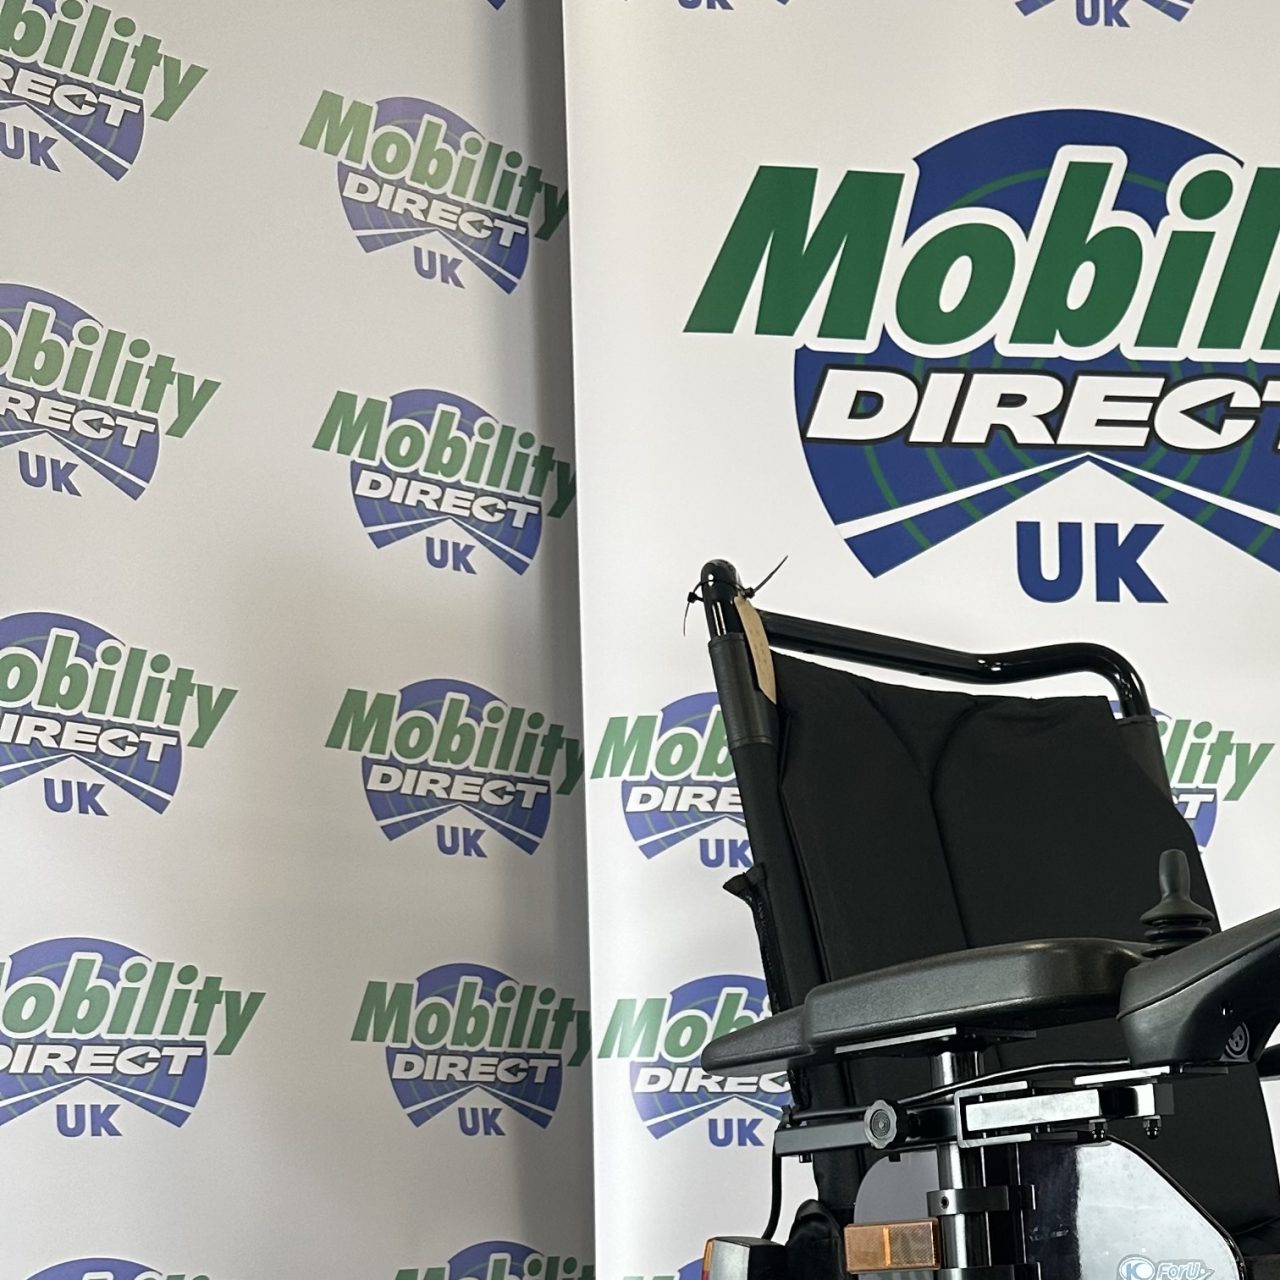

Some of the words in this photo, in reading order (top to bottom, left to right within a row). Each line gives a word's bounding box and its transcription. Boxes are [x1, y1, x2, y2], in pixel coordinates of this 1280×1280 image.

[1074, 0, 1131, 28] UK
[0, 122, 61, 173] UK
[299, 89, 568, 243] Mobility
[341, 170, 527, 250] DIRECT
[413, 245, 466, 289] UK
[0, 389, 156, 449] RECT
[18, 450, 82, 497] UK
[312, 390, 577, 519] Mobility
[354, 470, 541, 529] DIRECT
[425, 537, 478, 575] UK
[1014, 519, 1170, 605] UK
[0, 634, 239, 749] obility
[0, 713, 177, 763] IRECT
[324, 687, 585, 796] Mobility
[43, 778, 109, 817] UK
[366, 765, 549, 810] DIRECT
[436, 825, 488, 858] UK
[699, 838, 753, 868] UK
[0, 959, 266, 1056] obility
[0, 1044, 203, 1076] IRECT
[391, 1052, 560, 1085] DIRECT
[56, 1104, 122, 1138] UK
[457, 1106, 507, 1137] UK
[708, 1118, 765, 1148] UK
